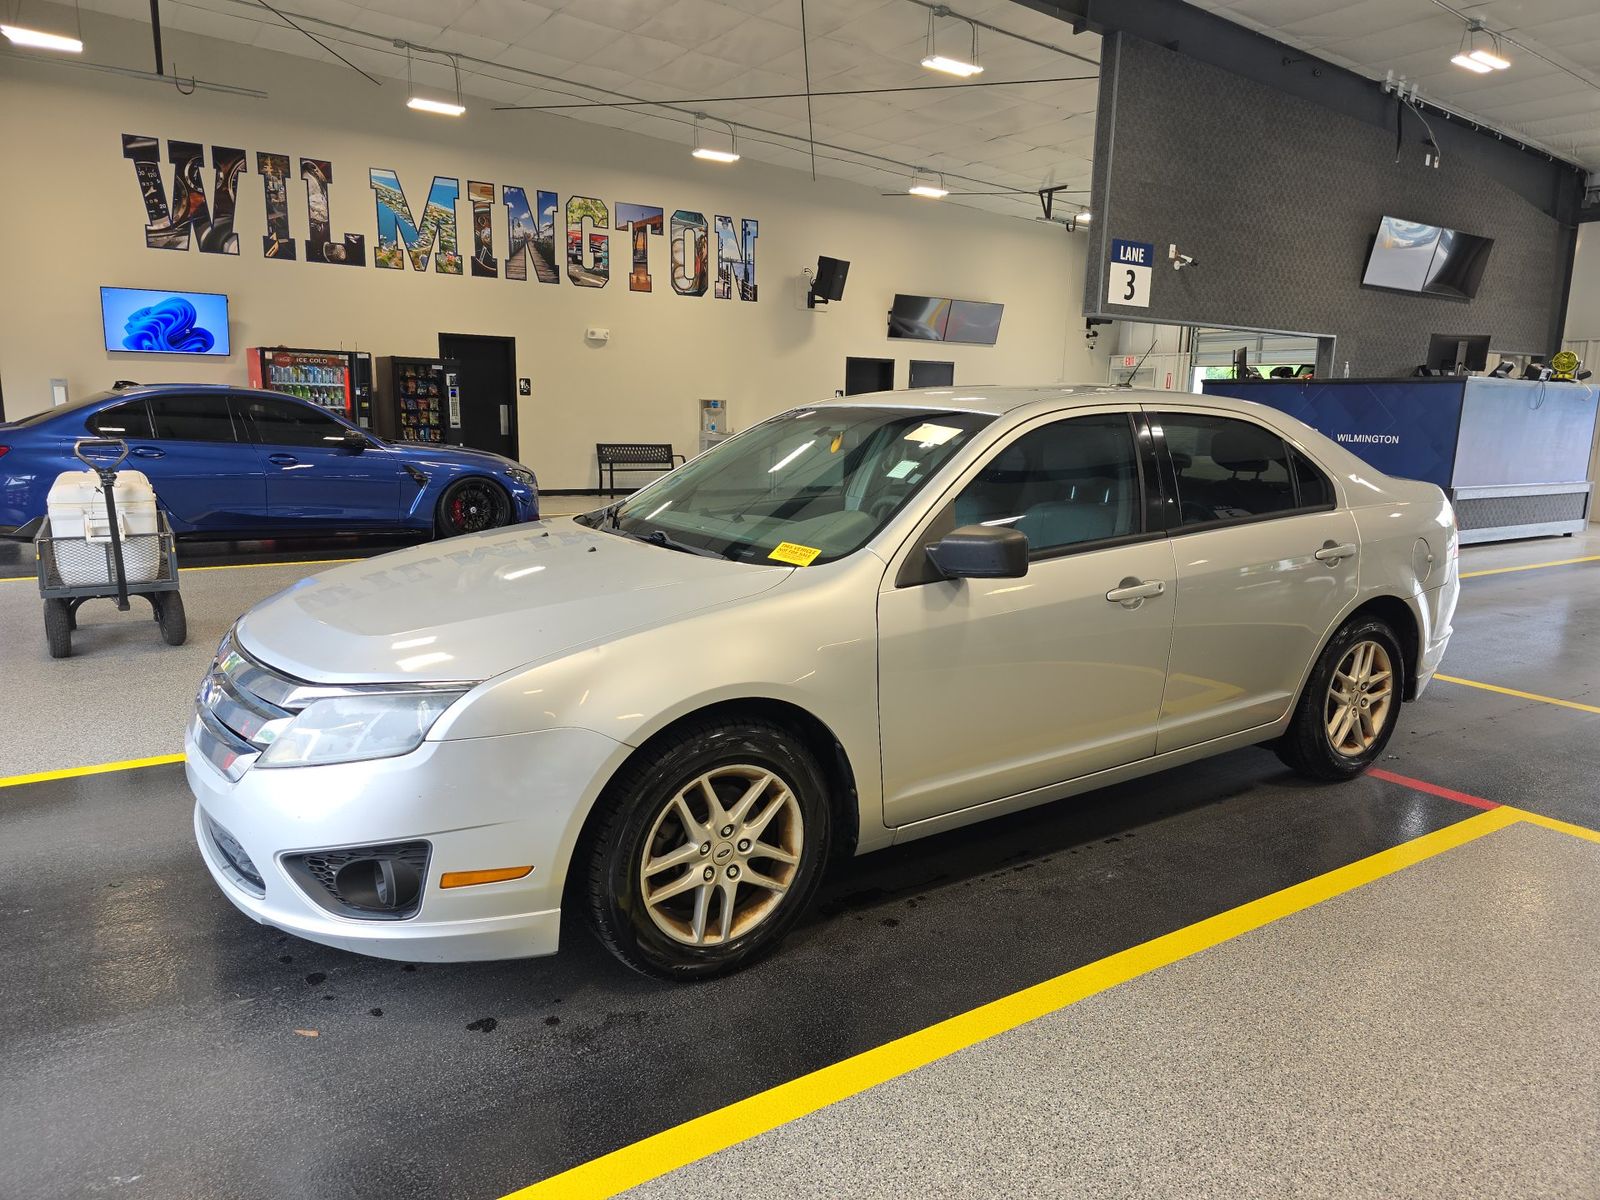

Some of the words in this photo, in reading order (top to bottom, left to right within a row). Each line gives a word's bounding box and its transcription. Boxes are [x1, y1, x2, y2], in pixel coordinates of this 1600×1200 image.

[121, 133, 758, 302] WILMINGTON
[1120, 245, 1145, 263] LANE
[1123, 269, 1136, 301] 3
[1337, 433, 1400, 444] WILMINGTON
